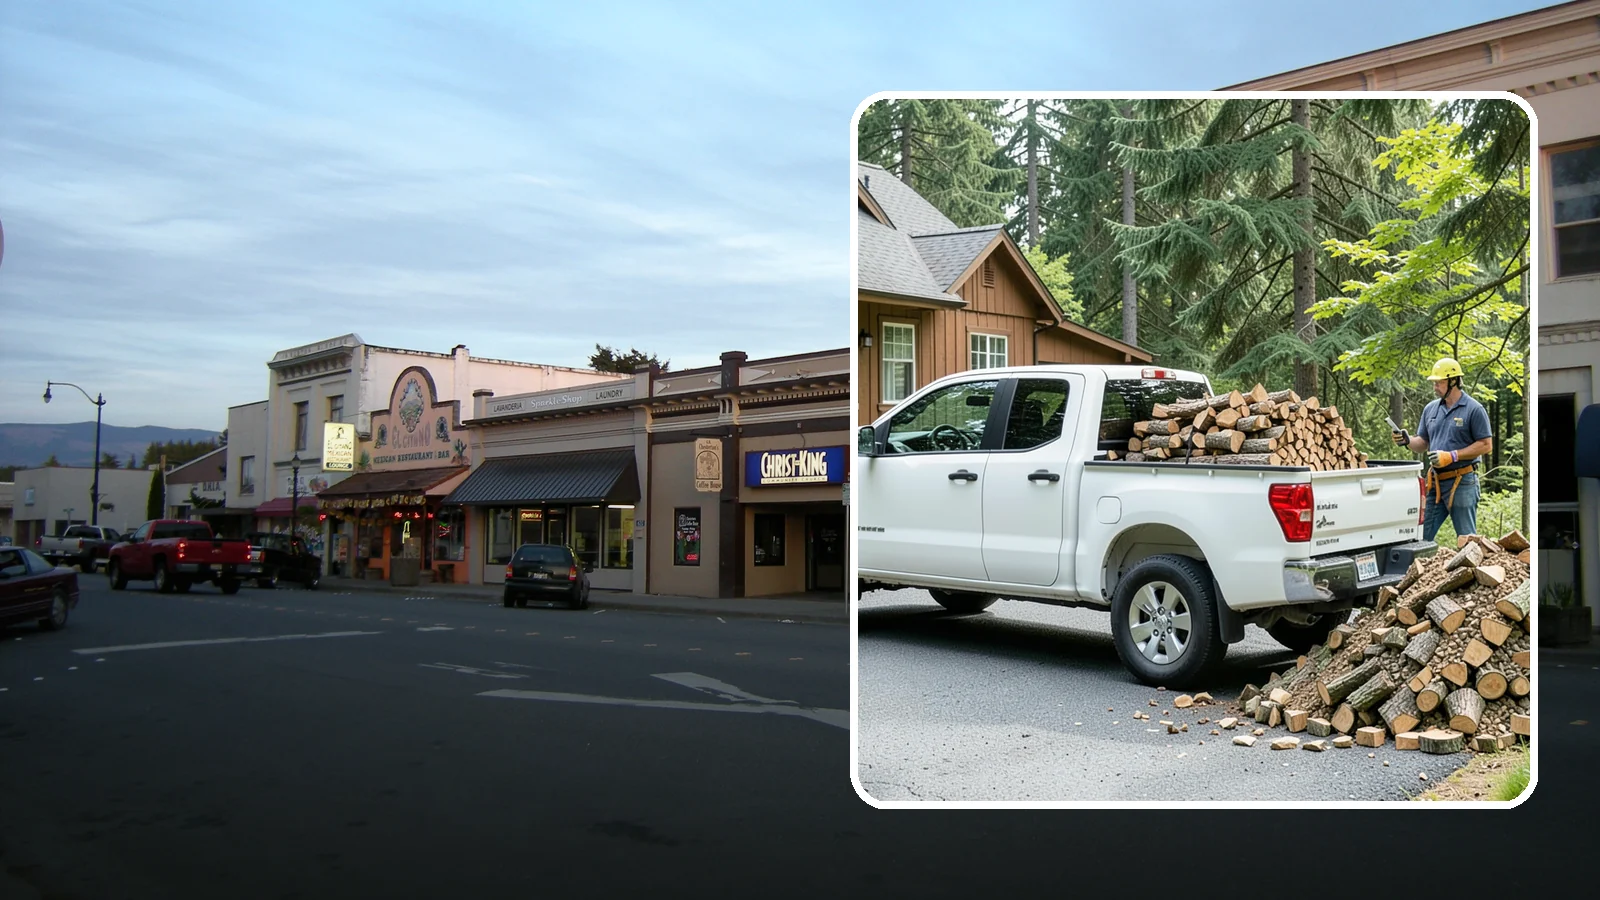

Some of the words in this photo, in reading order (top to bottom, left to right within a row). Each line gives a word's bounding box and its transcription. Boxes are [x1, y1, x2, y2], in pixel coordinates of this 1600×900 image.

[493, 402, 522, 412] LAVANDERIA
[595, 388, 623, 400] LAUNDRY
[398, 451, 433, 462] RESTAURANT
[438, 450, 450, 459] BAR
[799, 450, 827, 476] KING
